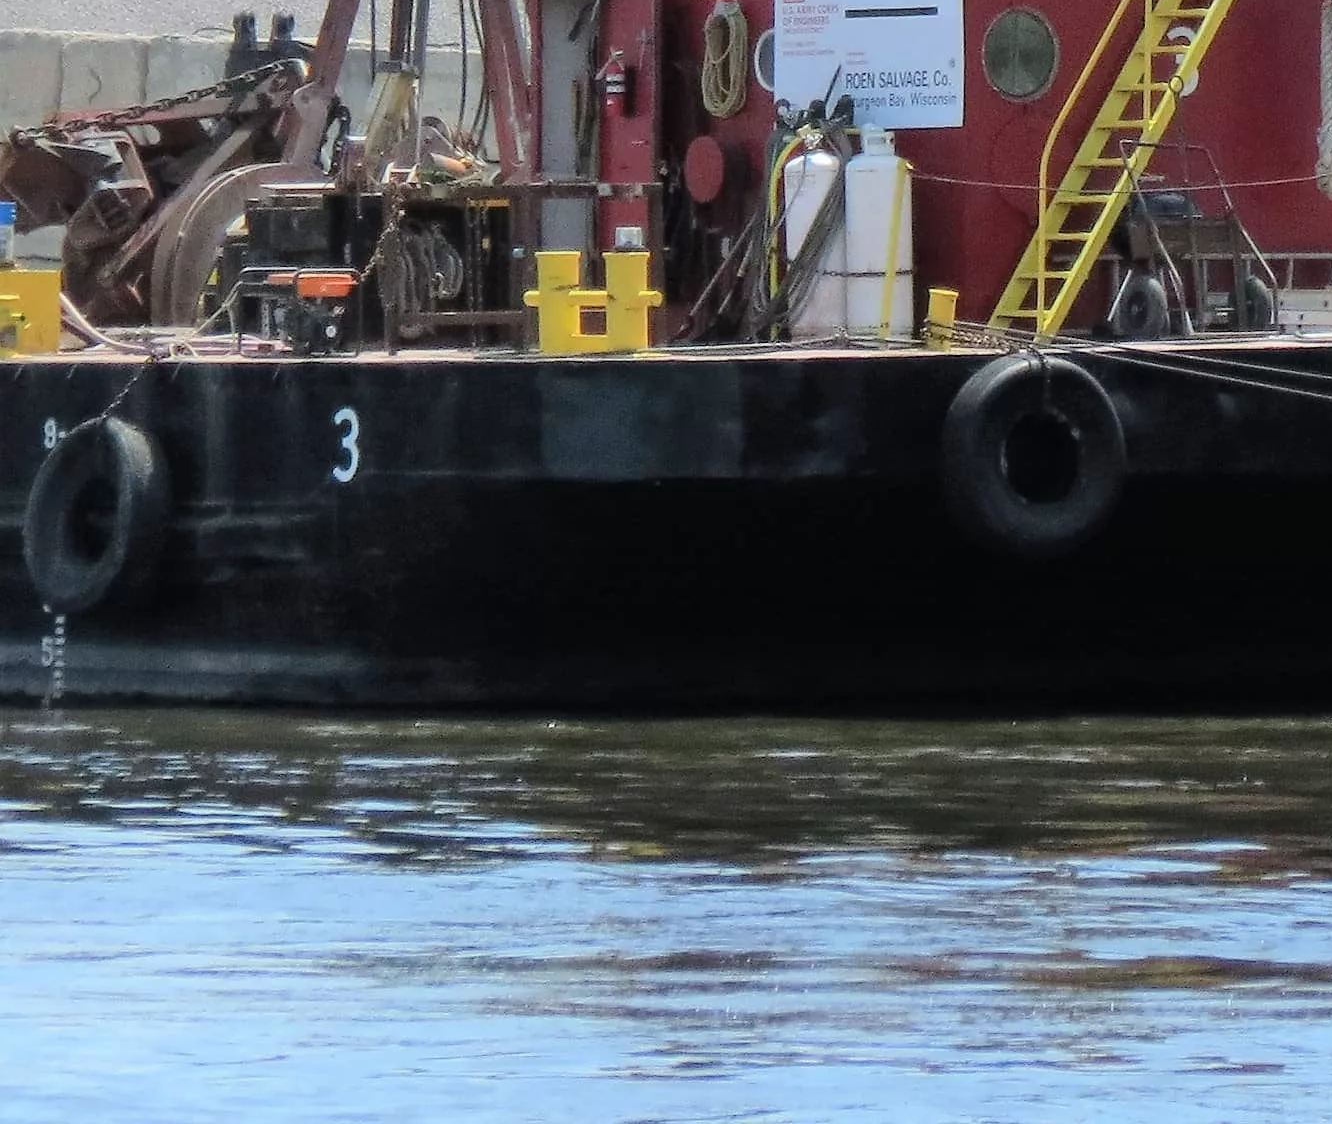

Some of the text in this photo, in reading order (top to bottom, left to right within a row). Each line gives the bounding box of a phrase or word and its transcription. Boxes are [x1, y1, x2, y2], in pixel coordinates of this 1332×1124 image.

[846, 72, 875, 89] ROEN
[910, 91, 957, 106] Wisconsin
[43, 418, 57, 449] 8
[332, 407, 361, 482] 3
